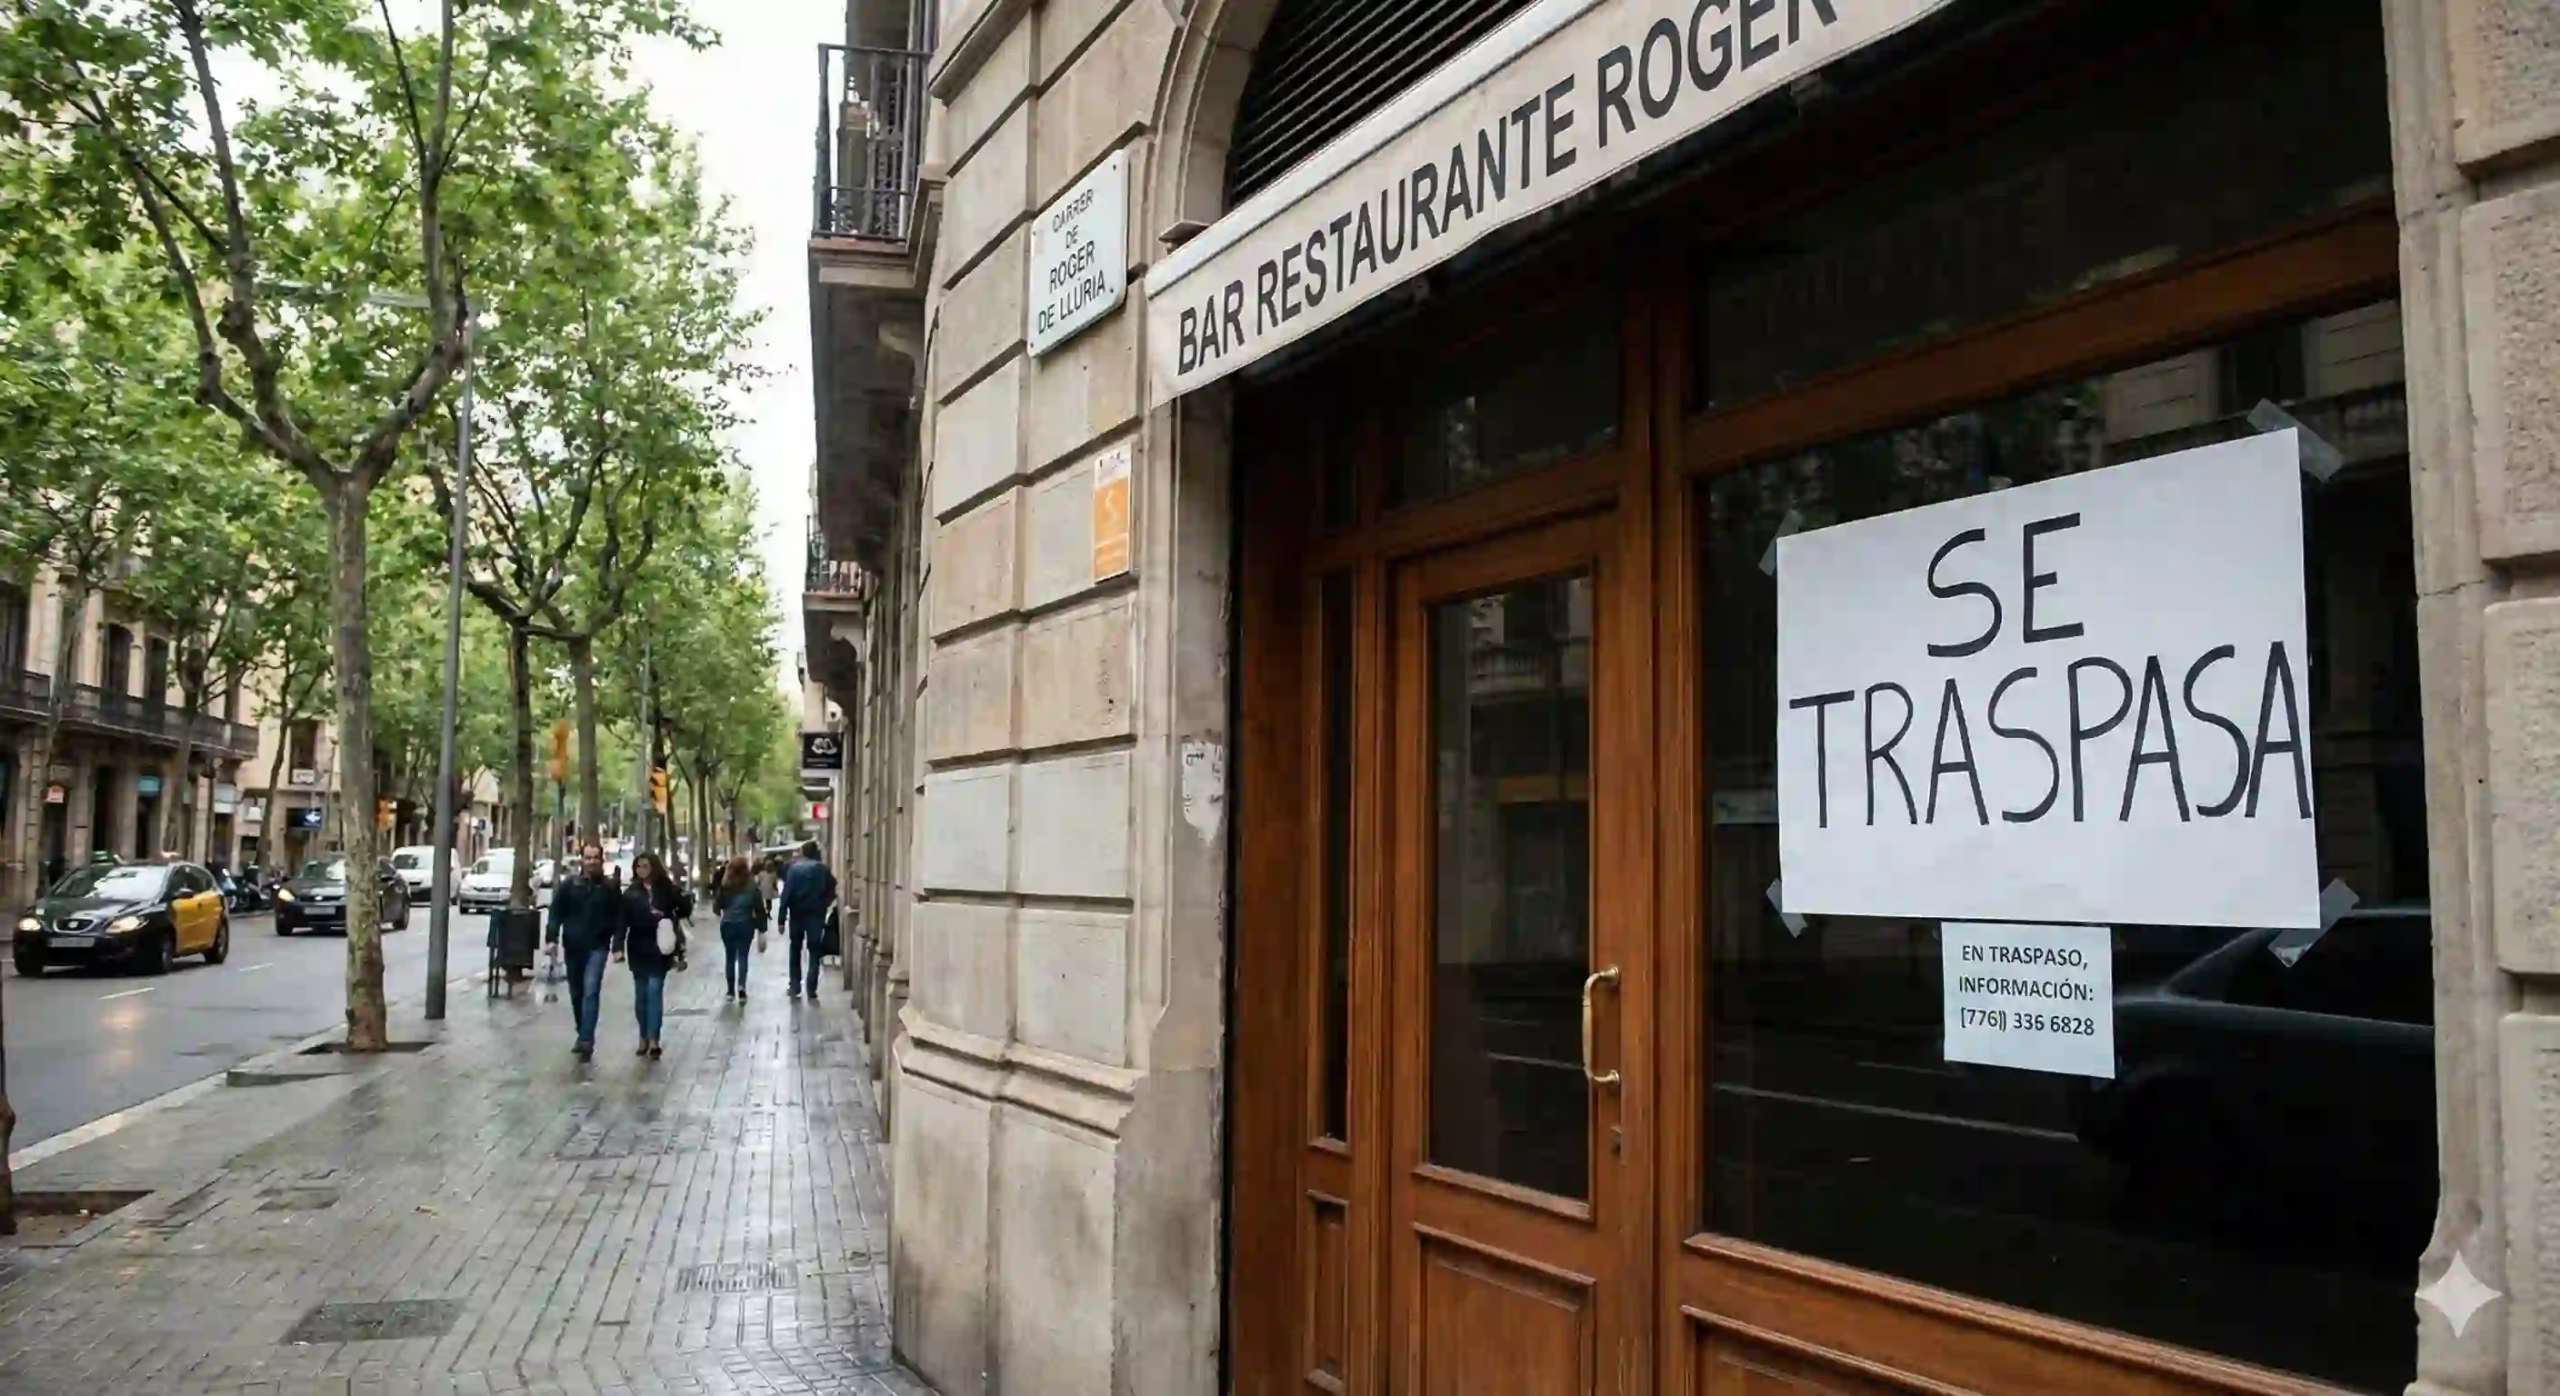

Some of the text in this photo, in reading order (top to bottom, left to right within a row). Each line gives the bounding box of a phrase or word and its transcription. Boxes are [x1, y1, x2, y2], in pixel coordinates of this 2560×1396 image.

[1053, 188, 1093, 233] CARRER
[1178, 279, 1245, 375] BAR
[1257, 73, 1577, 336] RESTAURANTE
[1066, 225, 1079, 249] DE
[1050, 239, 1095, 294] ROGER
[1038, 303, 1056, 335] DE
[1926, 512, 2085, 658] SE
[1789, 640, 2313, 829] TRASPASA
[1962, 945, 2088, 970] EN TRASPASO,
[1959, 976, 2094, 1001] INFORMACIÓN:
[2013, 1012, 2045, 1031] 336
[2050, 1015, 2095, 1036] 6828
